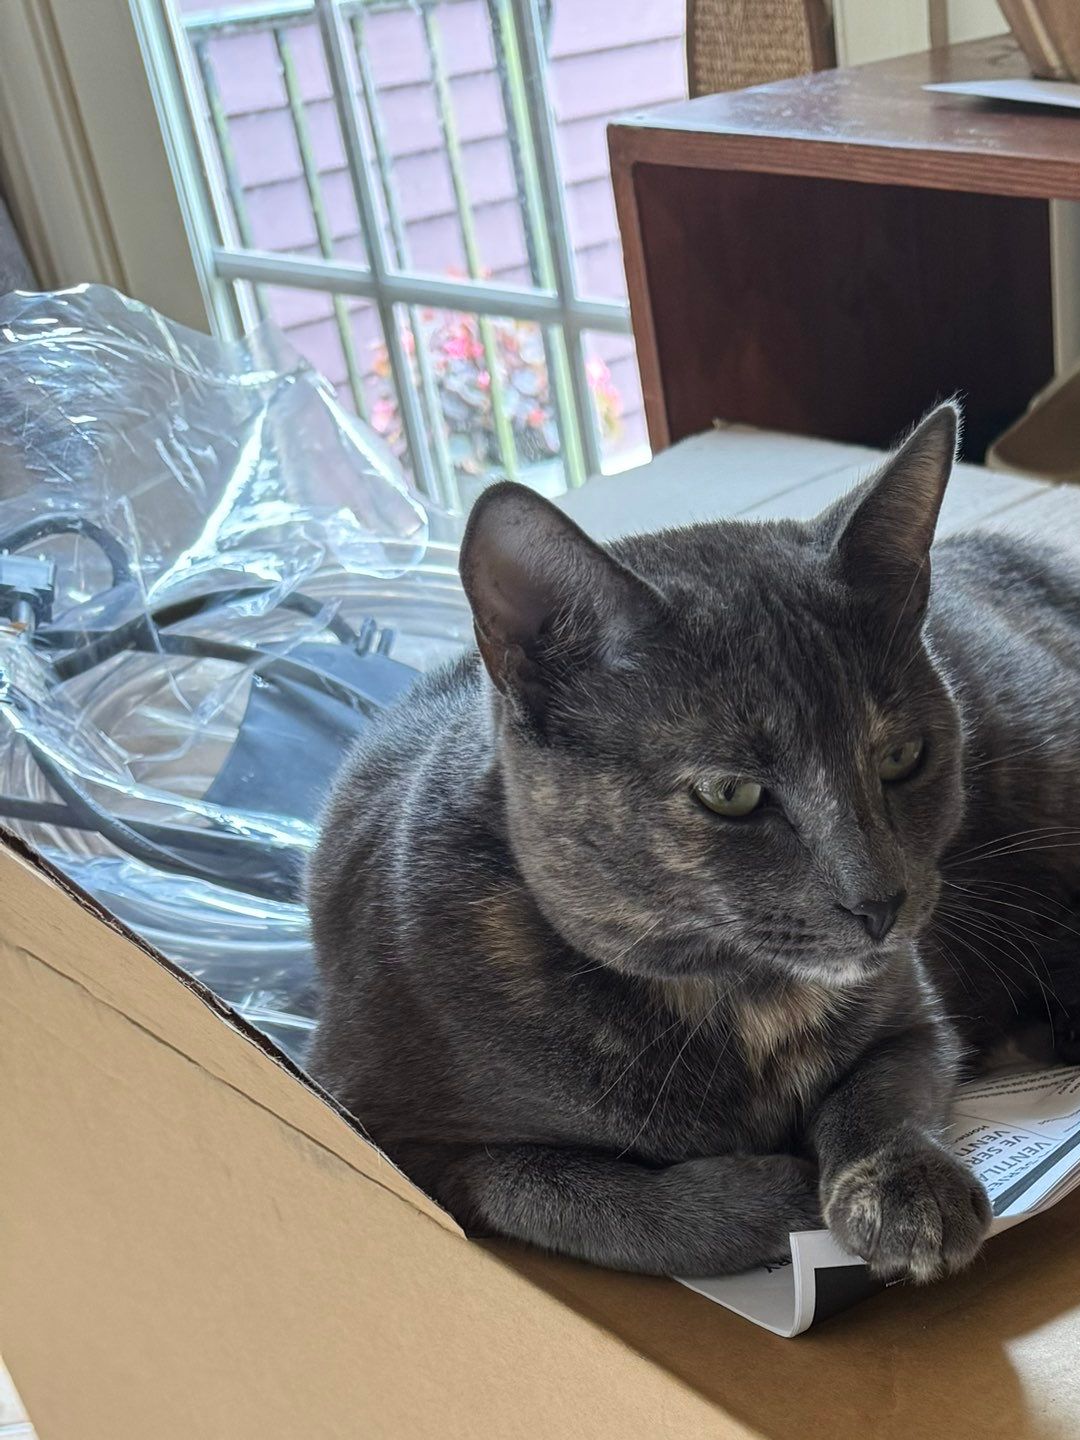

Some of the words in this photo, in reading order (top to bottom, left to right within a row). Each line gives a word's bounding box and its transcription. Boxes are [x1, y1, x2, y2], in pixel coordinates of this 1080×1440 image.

[954, 1130, 1011, 1157] VENTI
[967, 1146, 1003, 1168] SER
[979, 1142, 1052, 1182] VENTILA
